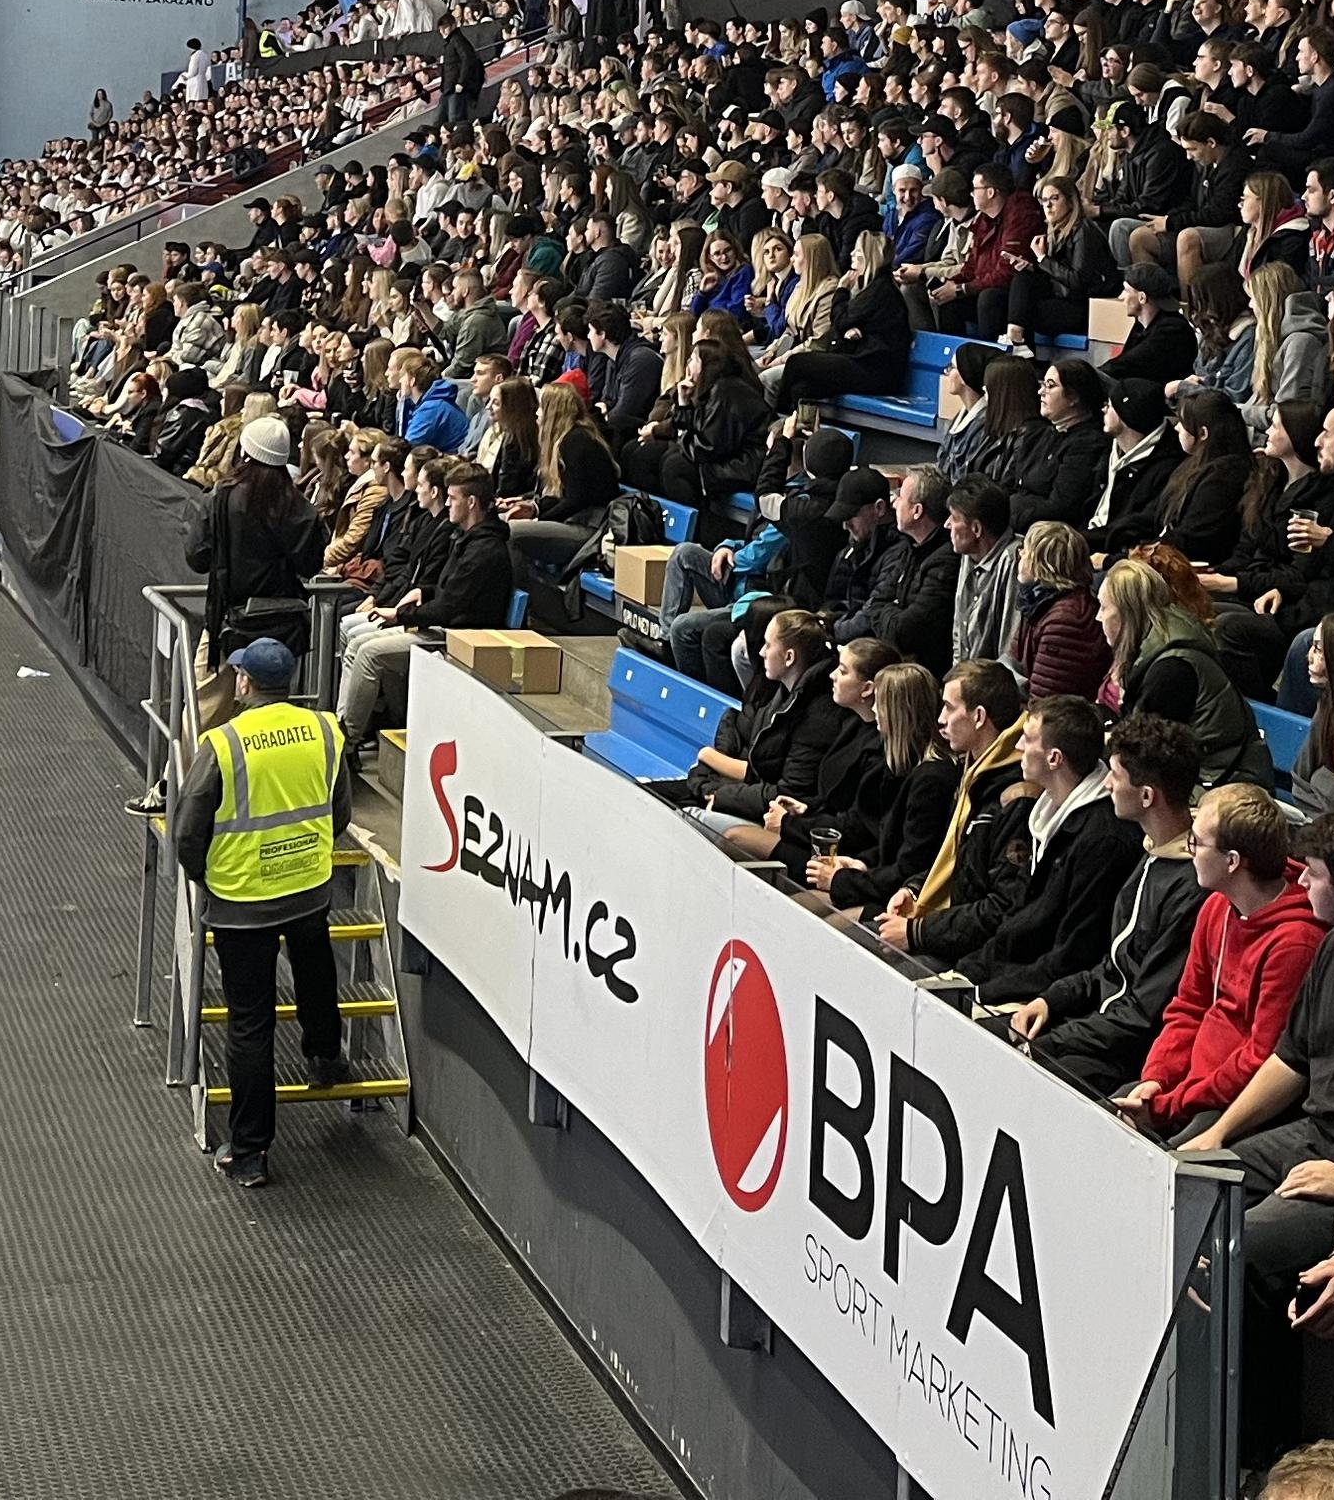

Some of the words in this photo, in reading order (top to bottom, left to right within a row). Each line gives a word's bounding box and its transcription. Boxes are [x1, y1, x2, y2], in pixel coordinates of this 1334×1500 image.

[242, 724, 317, 753] POŘADATEL
[808, 994, 1056, 1430] BPA
[804, 1233, 883, 1338] SPORT
[888, 1315, 1052, 1500] MARKETING
